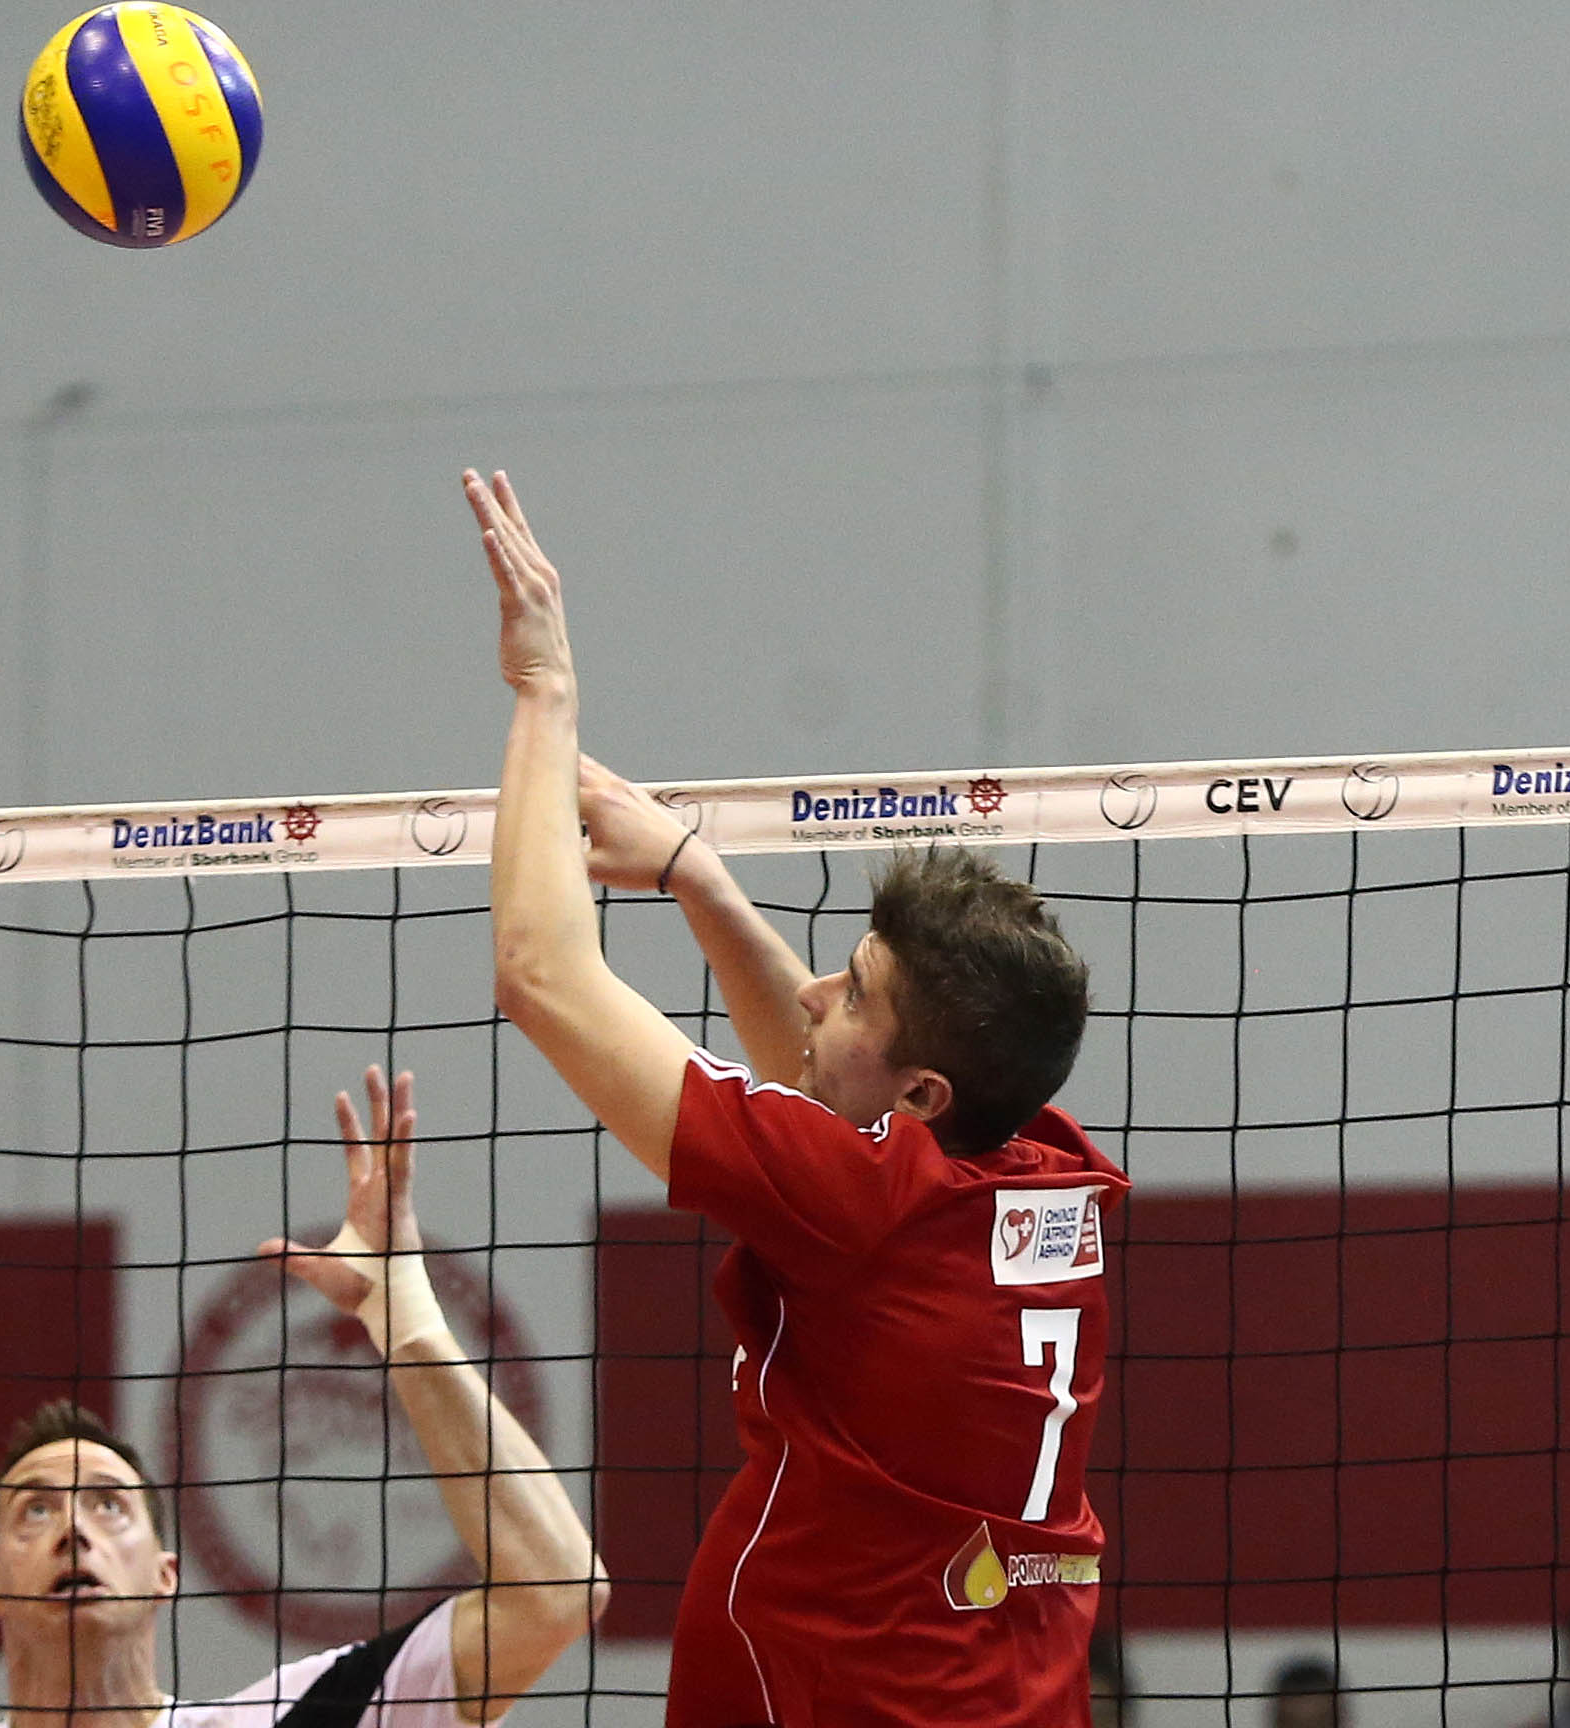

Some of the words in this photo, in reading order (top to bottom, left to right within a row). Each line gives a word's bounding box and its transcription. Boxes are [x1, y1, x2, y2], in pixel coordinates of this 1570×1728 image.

[792, 785, 960, 822] DenizBank
[1205, 776, 1294, 815] CEV
[1492, 801, 1553, 816] Member
[1556, 800, 1570, 814] of
[112, 813, 275, 849] DenizBank
[792, 828, 851, 842] Member
[853, 827, 868, 840] of
[872, 823, 955, 839] Sberbank
[959, 822, 1005, 837] Group
[191, 852, 271, 867] Sberbank
[1020, 1308, 1082, 1521] 7
